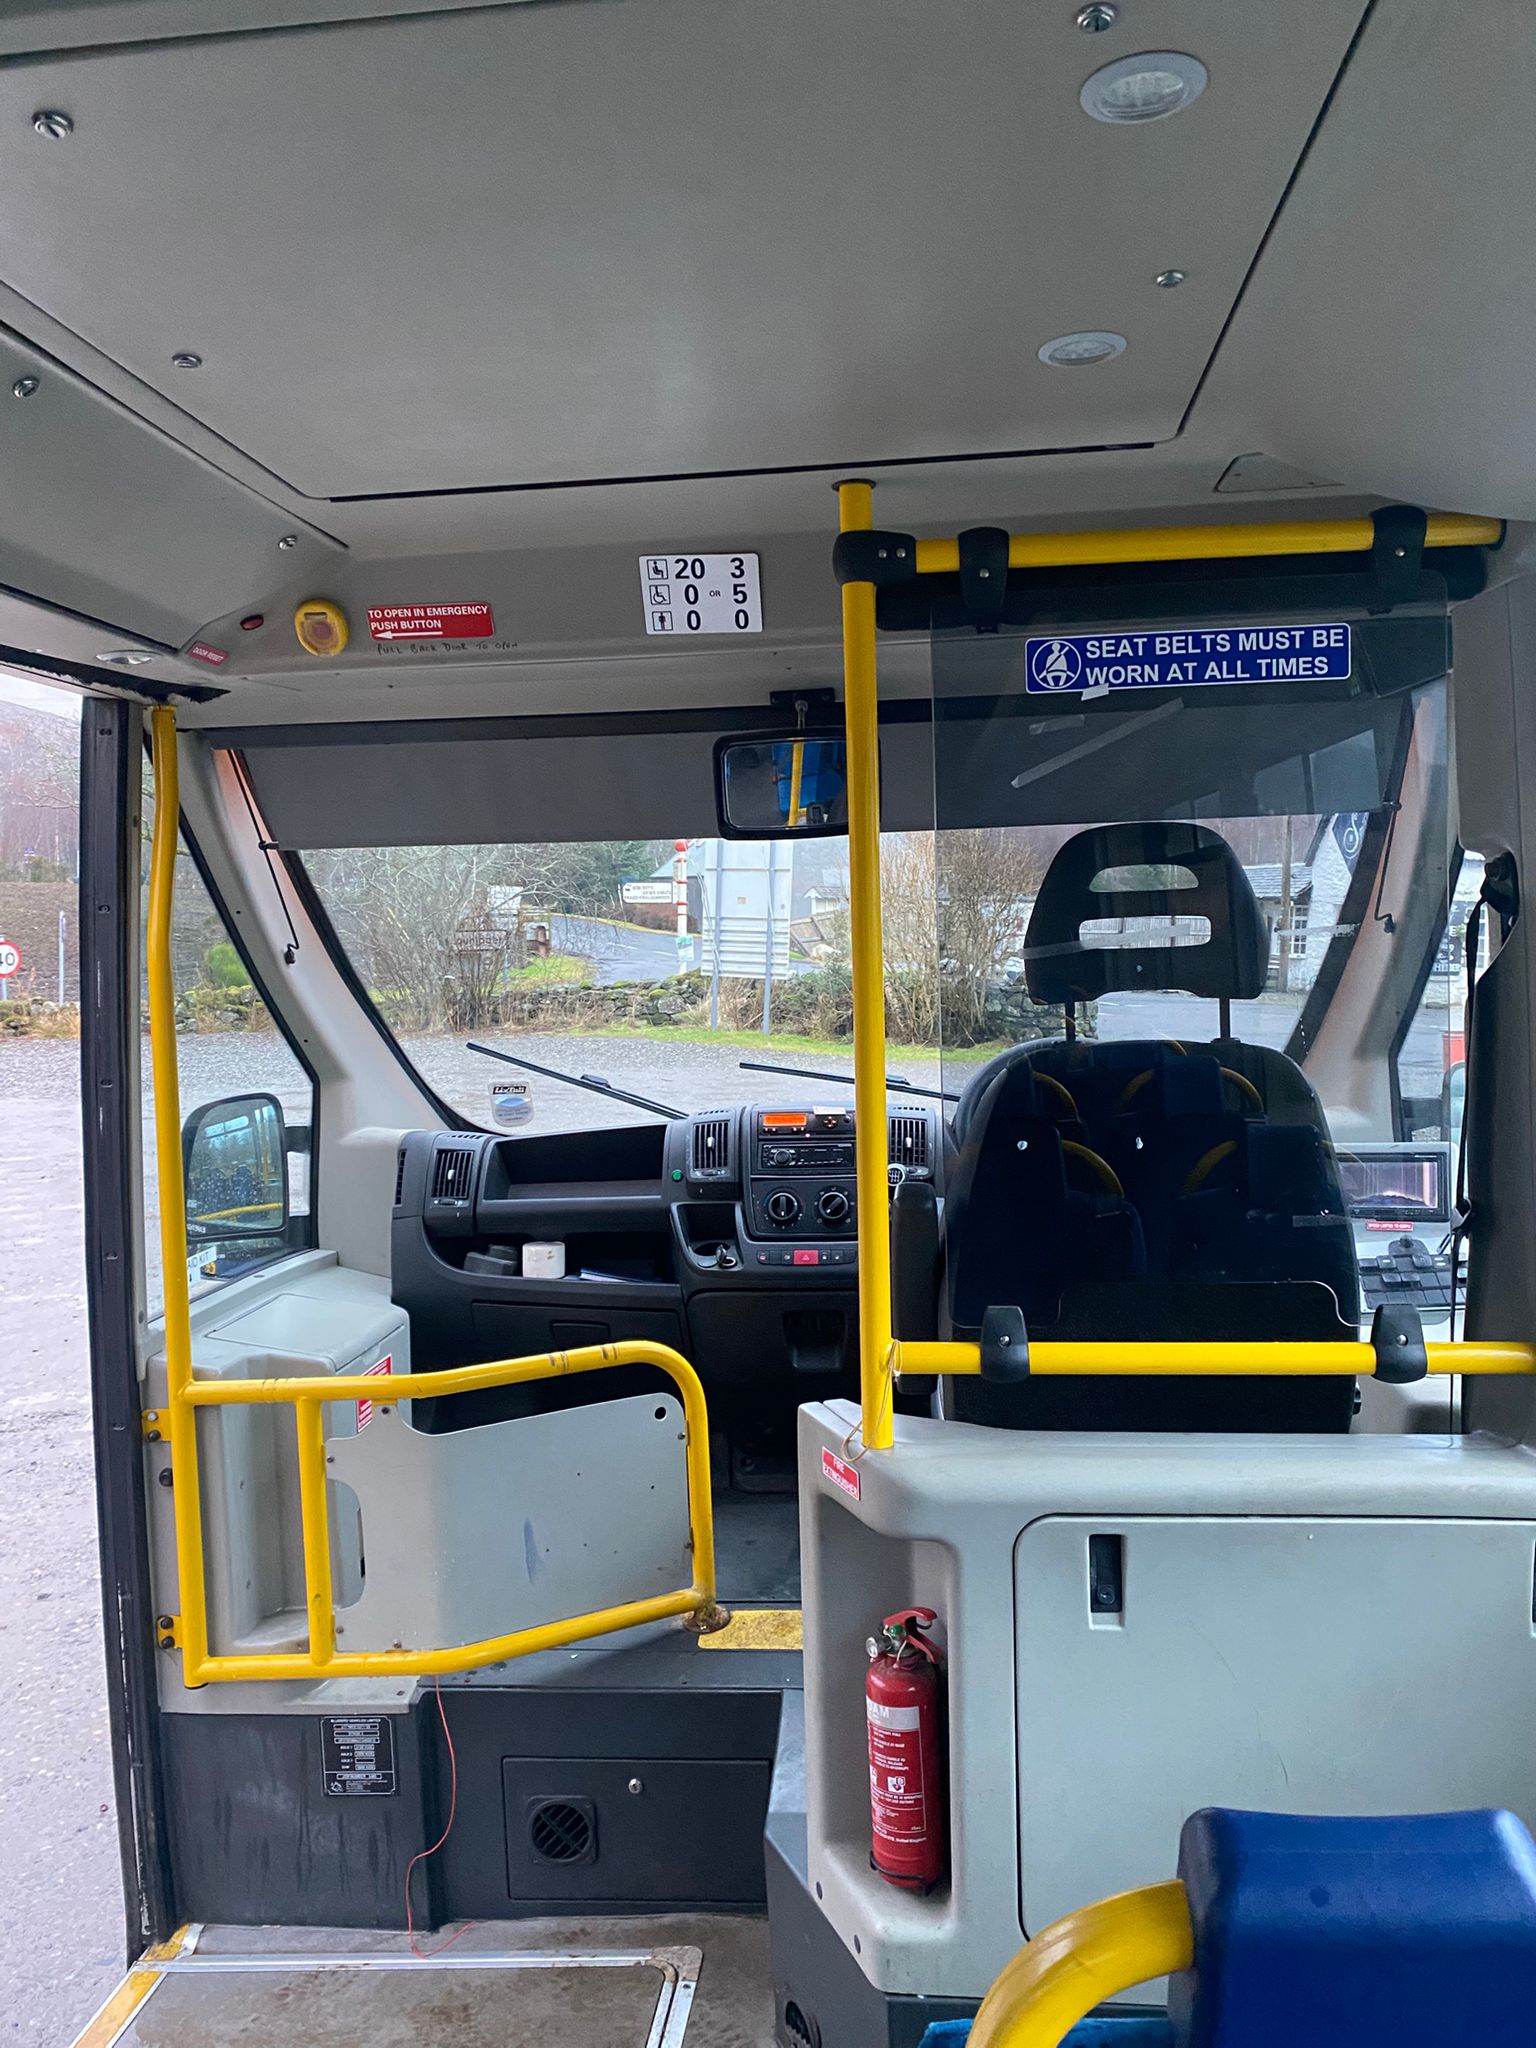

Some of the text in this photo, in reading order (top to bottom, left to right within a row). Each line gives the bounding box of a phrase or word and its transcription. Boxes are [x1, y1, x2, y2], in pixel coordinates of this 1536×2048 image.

[674, 557, 745, 580] 20 3
[684, 583, 748, 605] 0 OR 5
[368, 605, 488, 619] TO OPEN IN EMERGENCY
[686, 608, 749, 631] 0 0
[370, 619, 442, 631] PUSH BUTTON
[1085, 628, 1345, 659] SEAT BELTS MUST BE
[1085, 656, 1330, 686] WORN AT ALL TIMES
[833, 1457, 845, 1474] FIRE
